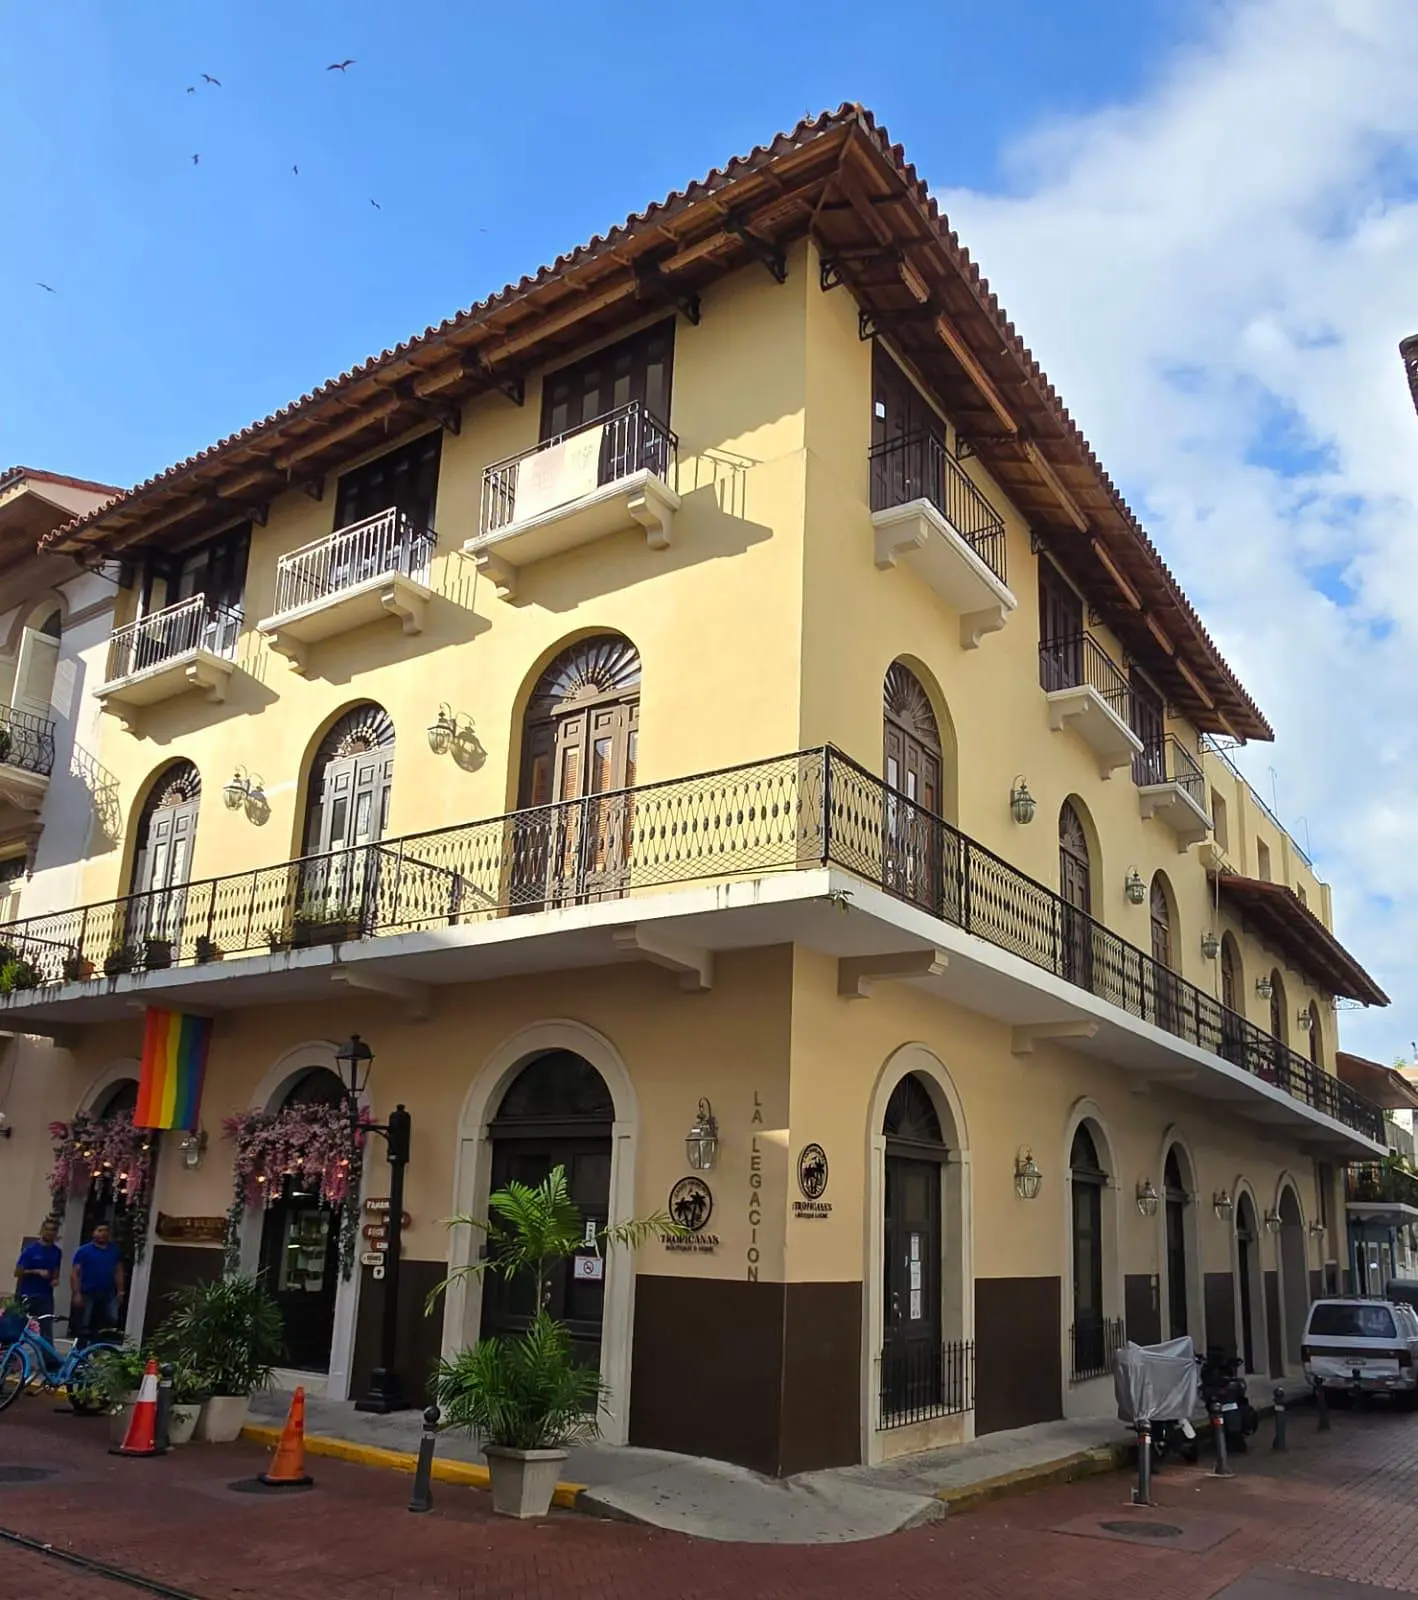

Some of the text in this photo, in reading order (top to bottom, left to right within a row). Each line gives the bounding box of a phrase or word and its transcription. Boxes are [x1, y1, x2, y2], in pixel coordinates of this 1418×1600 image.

[747, 1091, 763, 1282] LA LEGACION
[660, 1234, 719, 1245] TROPICANAS
